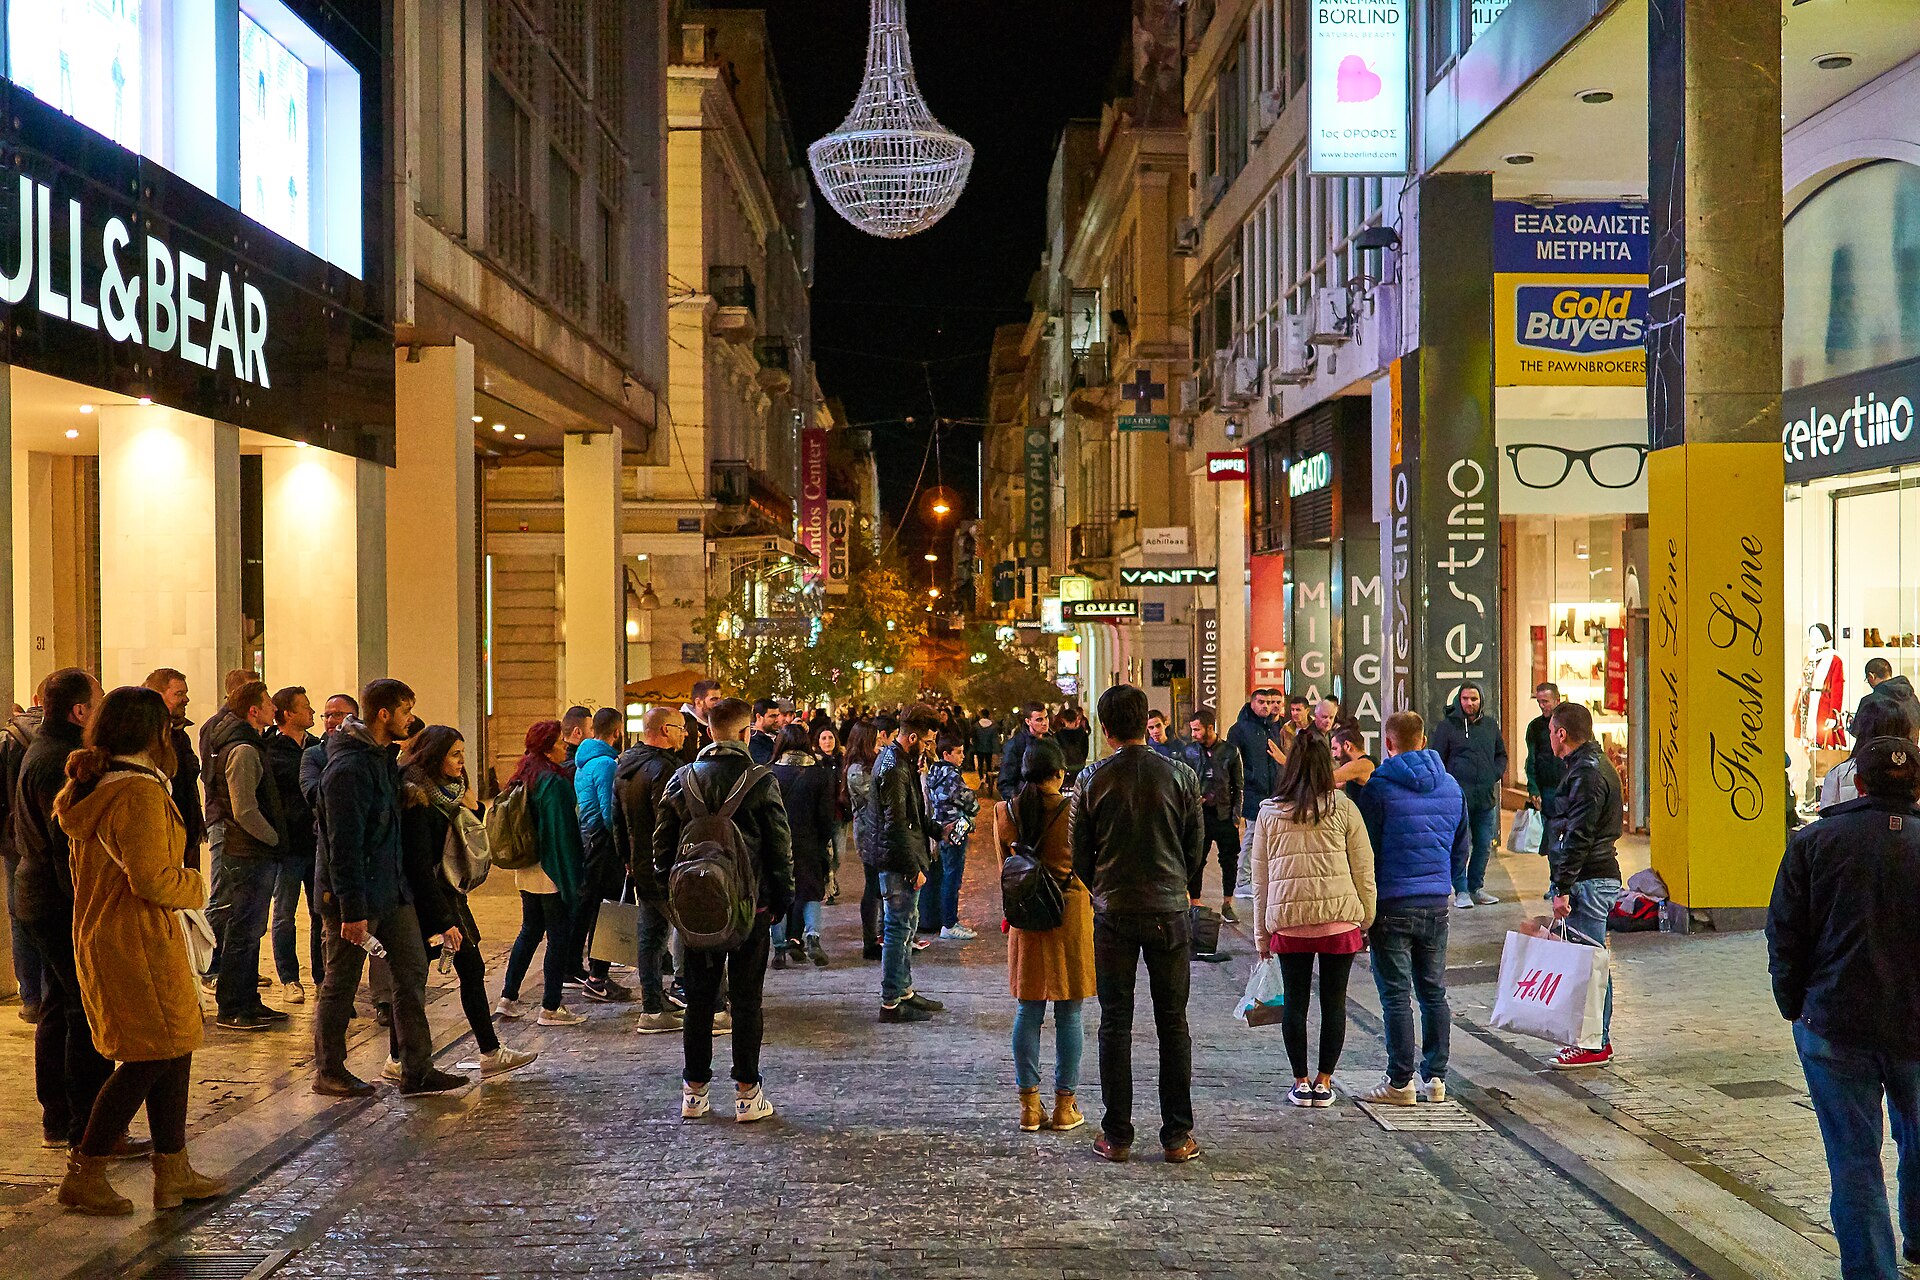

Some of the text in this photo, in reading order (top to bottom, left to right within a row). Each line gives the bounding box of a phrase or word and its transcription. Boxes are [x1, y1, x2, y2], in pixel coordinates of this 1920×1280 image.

[1319, 8, 1400, 24] BÖRLIND
[1320, 151, 1398, 159] www.boerlind.com
[1536, 241, 1632, 260] ΜΕΤΡΗΤΑ
[1552, 290, 1632, 319] Gold
[1525, 311, 1643, 347] Buyers
[1520, 361, 1646, 373] THE PAWNBROKERS
[1782, 391, 1914, 464] celestino
[804, 440, 821, 500] Center
[1210, 459, 1246, 473] CAMPER
[1289, 451, 1329, 497] MIGATO
[1145, 538, 1184, 546] Achilleas
[1121, 570, 1216, 583] VANITY
[36, 636, 45, 651] 31
[1203, 620, 1216, 708] Achilleas
[1657, 538, 1679, 817] Fresh Line
[1707, 535, 1763, 821] Fresh Line
[1513, 968, 1563, 1006] H&M
